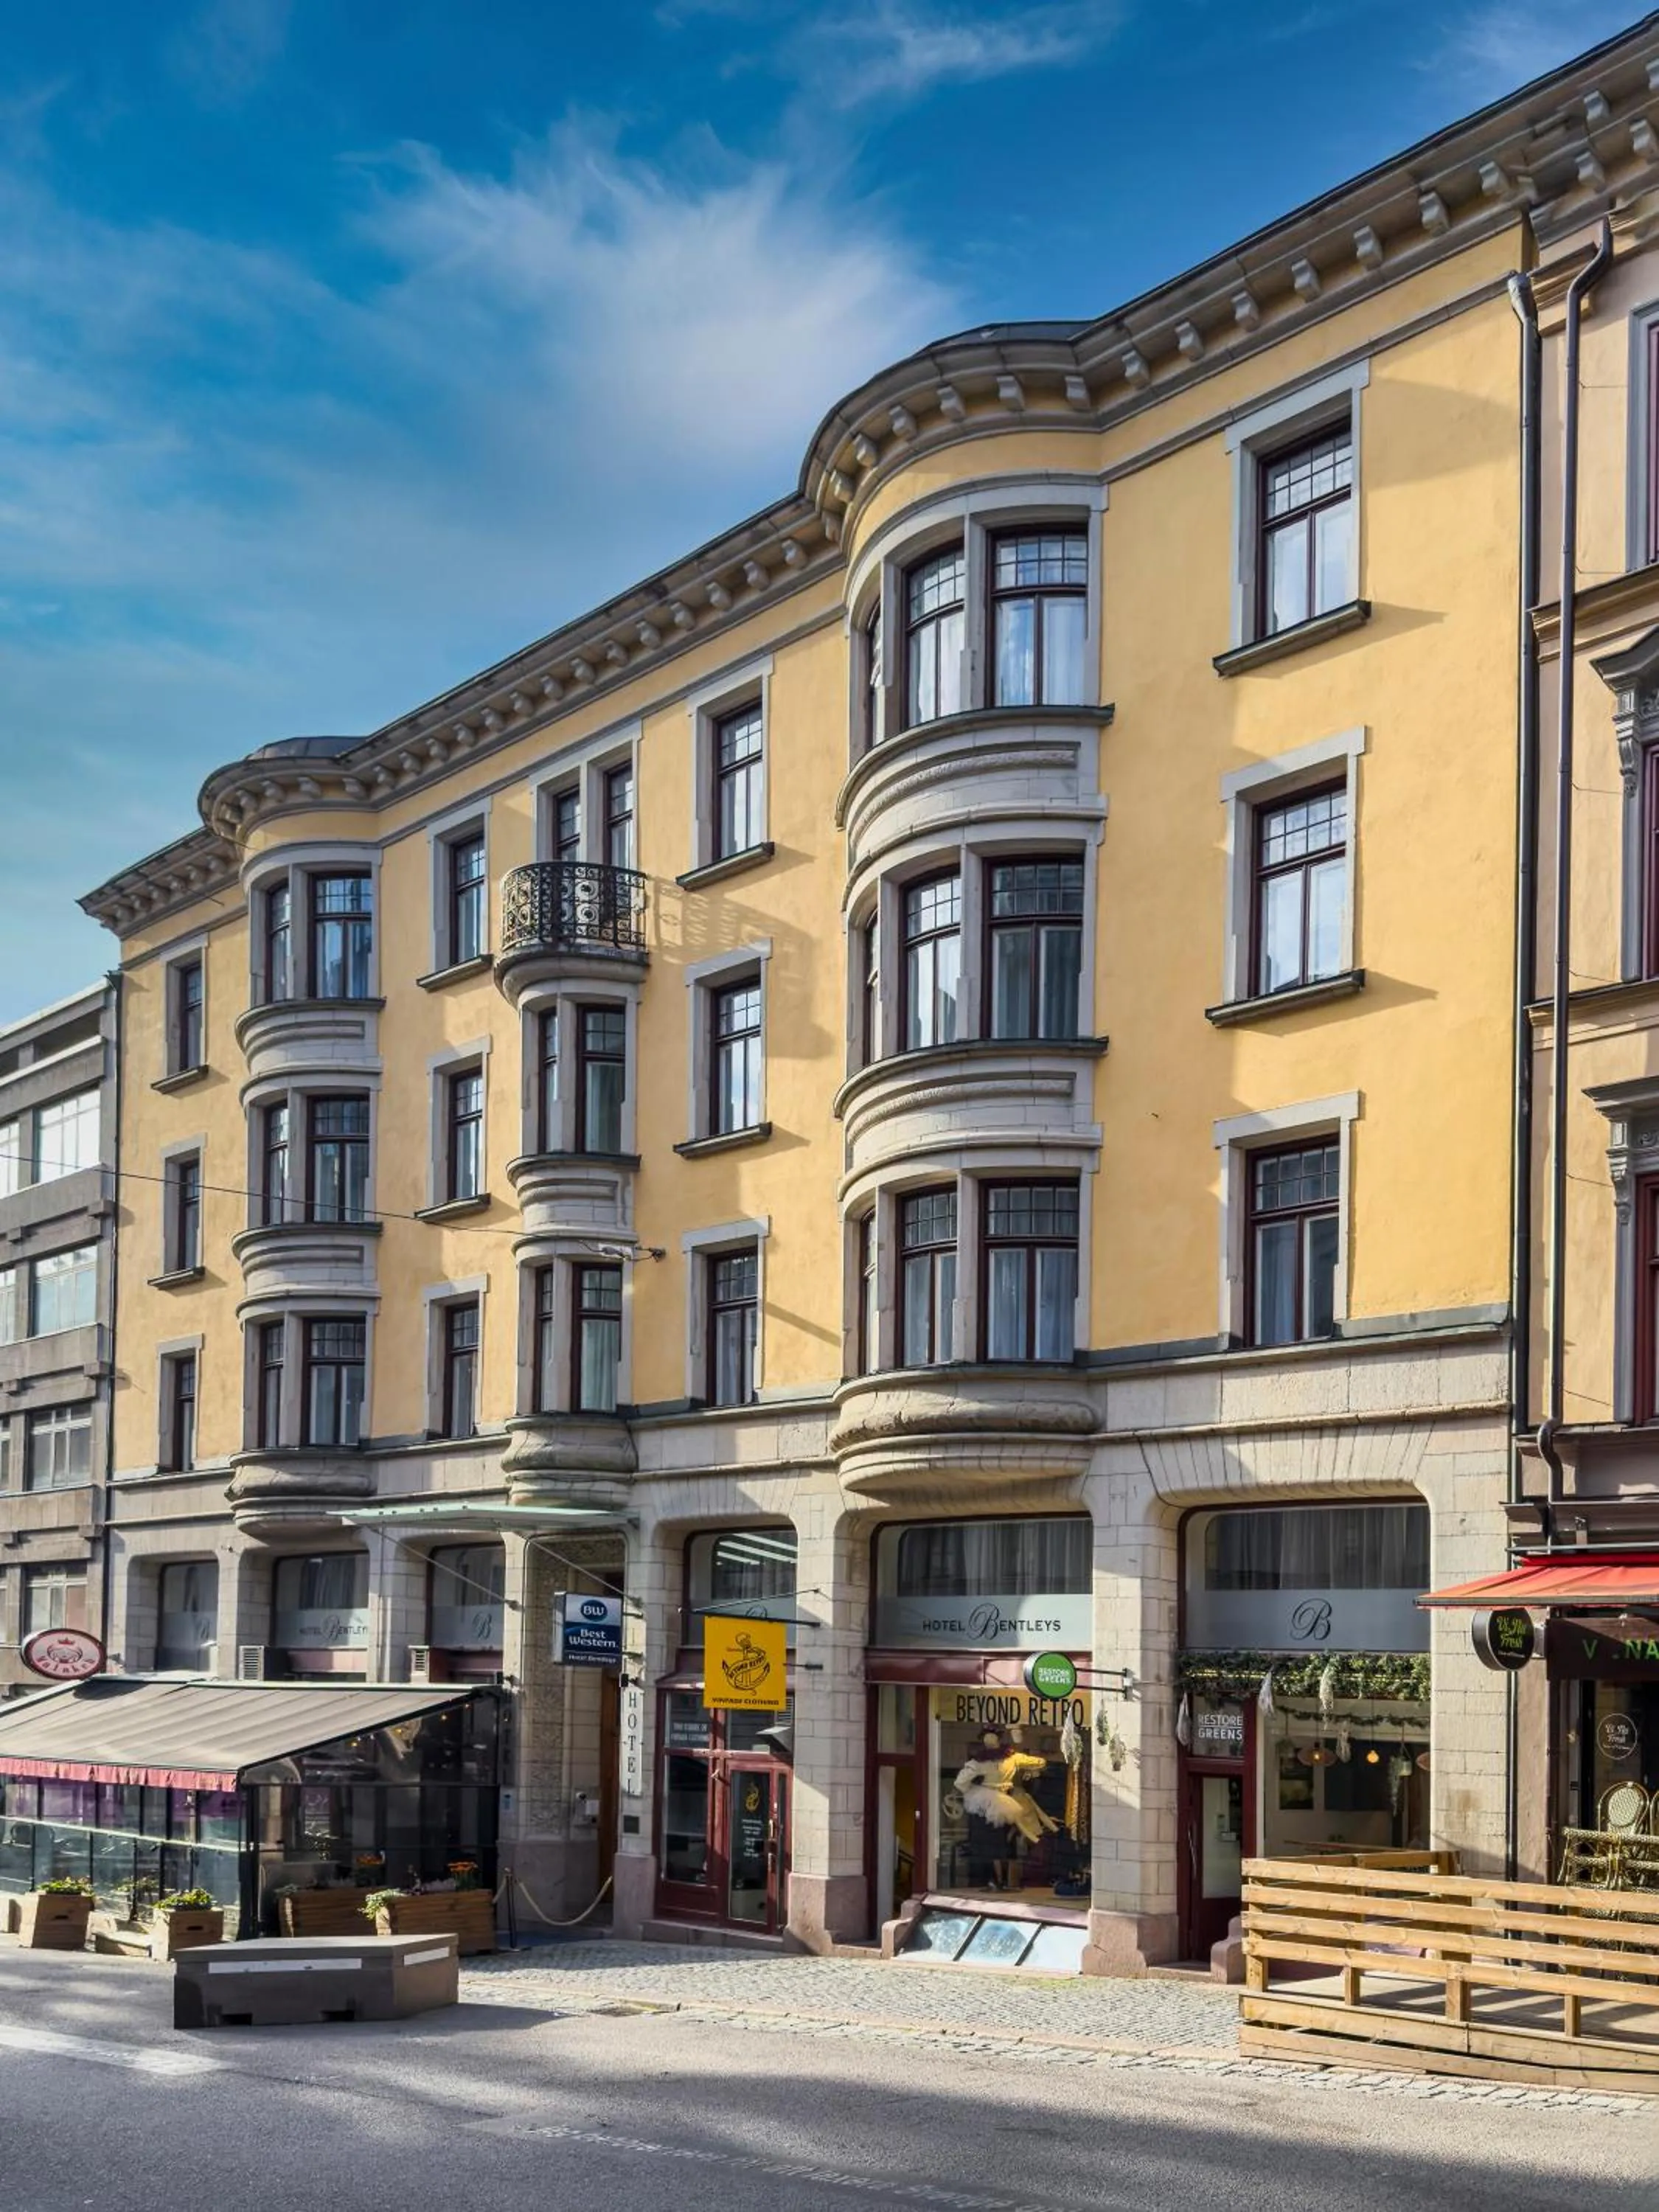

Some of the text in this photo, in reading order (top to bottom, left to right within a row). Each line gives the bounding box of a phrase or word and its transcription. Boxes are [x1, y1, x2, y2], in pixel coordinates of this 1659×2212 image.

[583, 1606, 605, 1615] BW
[922, 1602, 1062, 1641] HOTEL BENTLEYS
[1290, 1598, 1332, 1641] B
[580, 1629, 606, 1639] Best
[568, 1636, 616, 1648] Western
[956, 1695, 1084, 1727] BEYOND RETRO
[1197, 1714, 1244, 1725] RESTORE
[1198, 1728, 1243, 1740] GREENS
[627, 1691, 637, 1794] HOTEL
